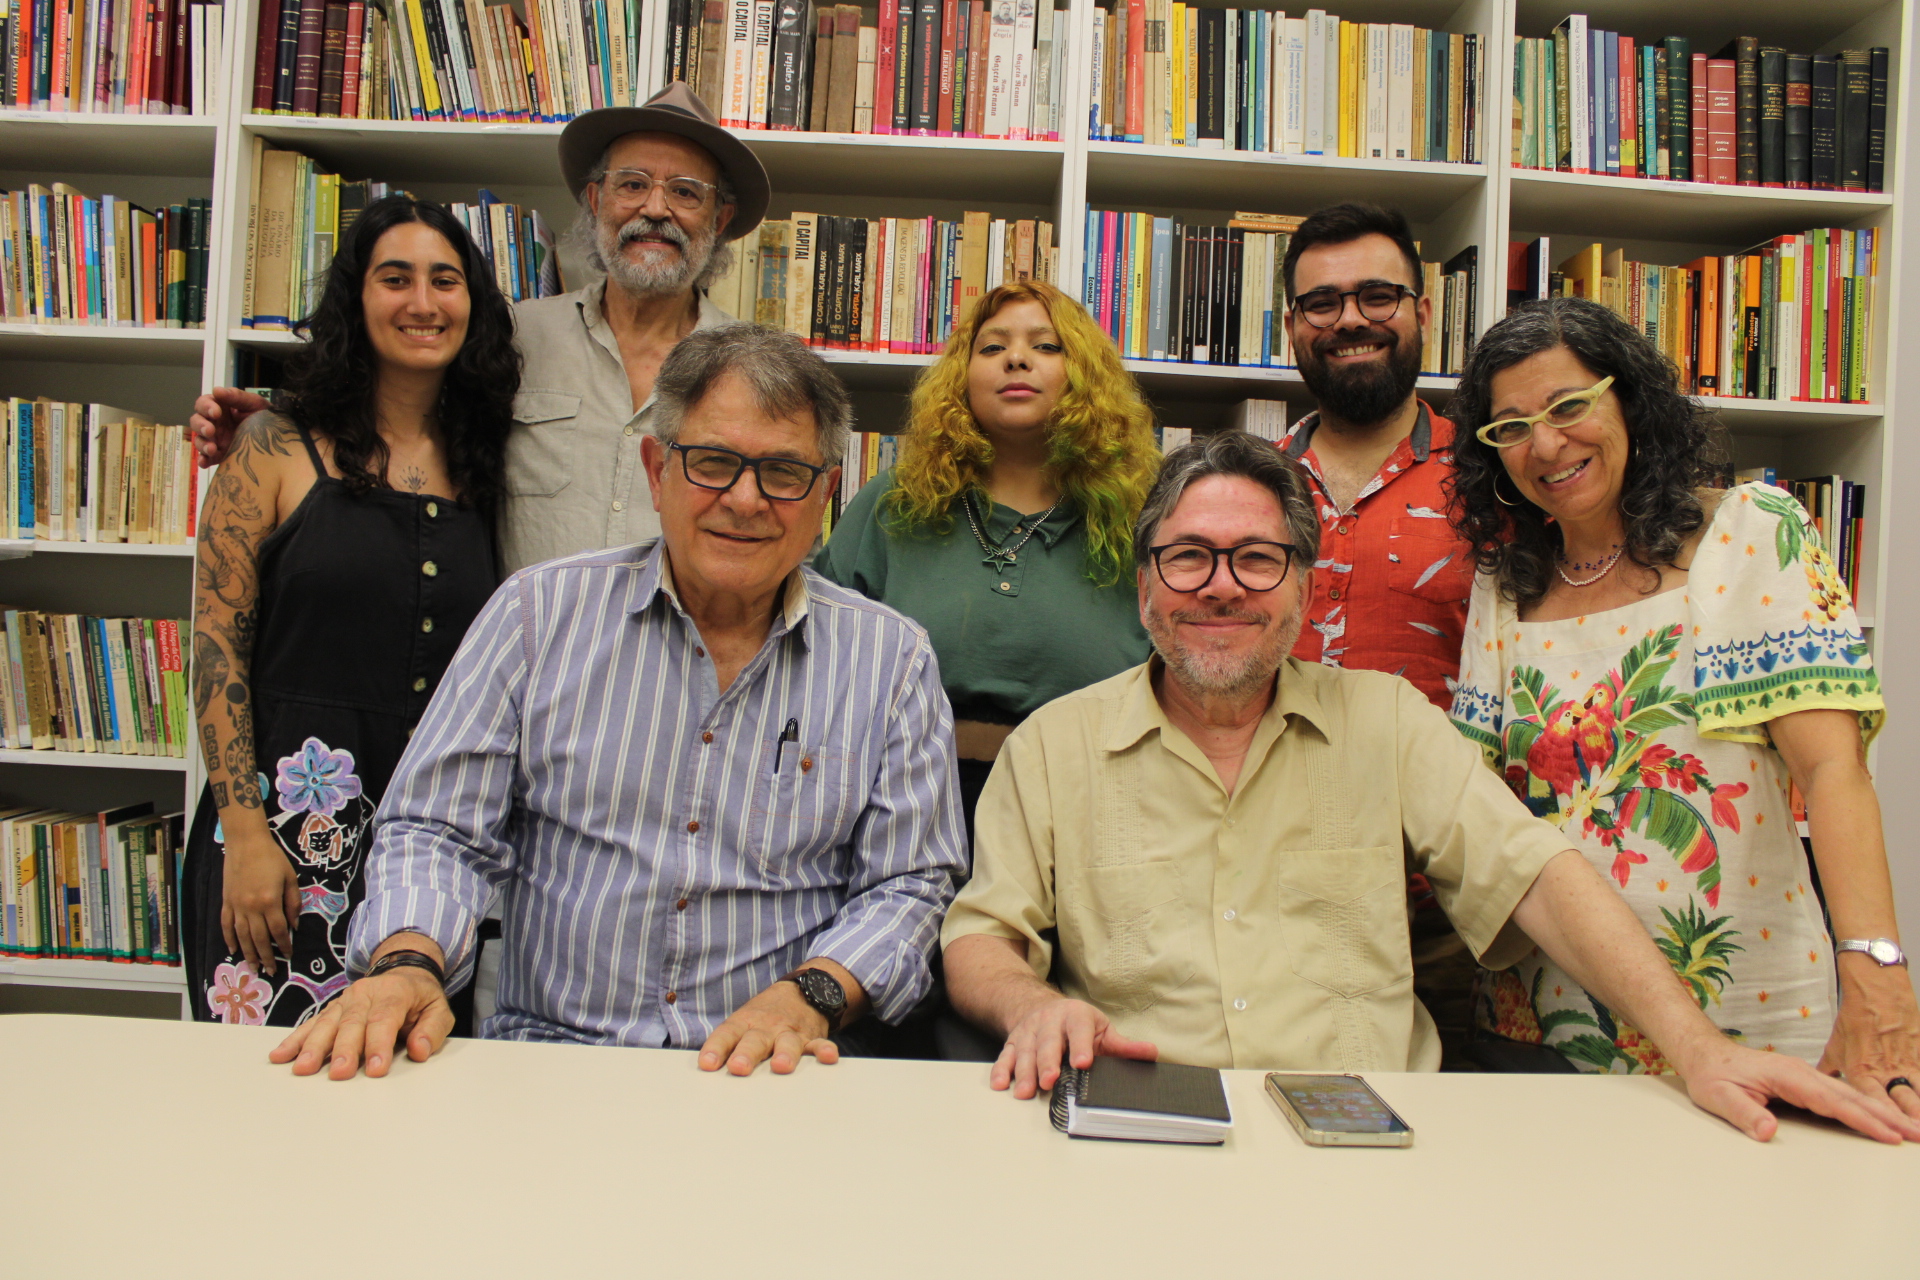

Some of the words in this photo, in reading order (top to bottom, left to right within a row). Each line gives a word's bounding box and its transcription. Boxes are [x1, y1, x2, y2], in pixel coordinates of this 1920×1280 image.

[690, 26, 698, 45] MARX
[734, 8, 748, 42] CAPITAL
[756, 13, 770, 47] CAPITAL
[673, 46, 682, 65] KARL
[1188, 28, 1196, 56] POLÍTICOS
[689, 47, 697, 66] KARL
[782, 52, 794, 83] capital
[899, 44, 908, 76] REVOLUÇÃO
[923, 44, 932, 75] REVOLUÇÃO
[954, 57, 964, 82] HISTÓRIA
[991, 55, 1001, 83] Gazeta
[1014, 54, 1022, 78] Gazeta
[673, 65, 682, 82] PITAL
[941, 49, 951, 94] LIBERALISMO
[898, 88, 906, 113] HISTÓRIA
[955, 83, 962, 91] DA
[1013, 80, 1021, 107] Renana
[990, 86, 999, 116] Renana
[248, 203, 257, 229] BRASIL
[260, 208, 270, 258] PORTUGUESA
[275, 211, 284, 258] DICIONÁRIO
[795, 228, 809, 260] CAPITAL
[899, 227, 907, 253] IMAGENS
[1155, 228, 1170, 236] ipea
[245, 243, 254, 280] EDUCAÇÃO
[899, 254, 907, 262] DA
[818, 271, 826, 289] KARL
[898, 262, 907, 295] REVOLUÇÃO
[243, 294, 251, 317] ATLAS
[835, 285, 843, 313] CAPITAL
[852, 292, 860, 319] CAPITAL
[159, 628, 168, 645] Mapa
[169, 630, 178, 646] Mapa
[94, 645, 104, 676] novíssima
[98, 677, 107, 702] história
[103, 711, 112, 738] filosofia
